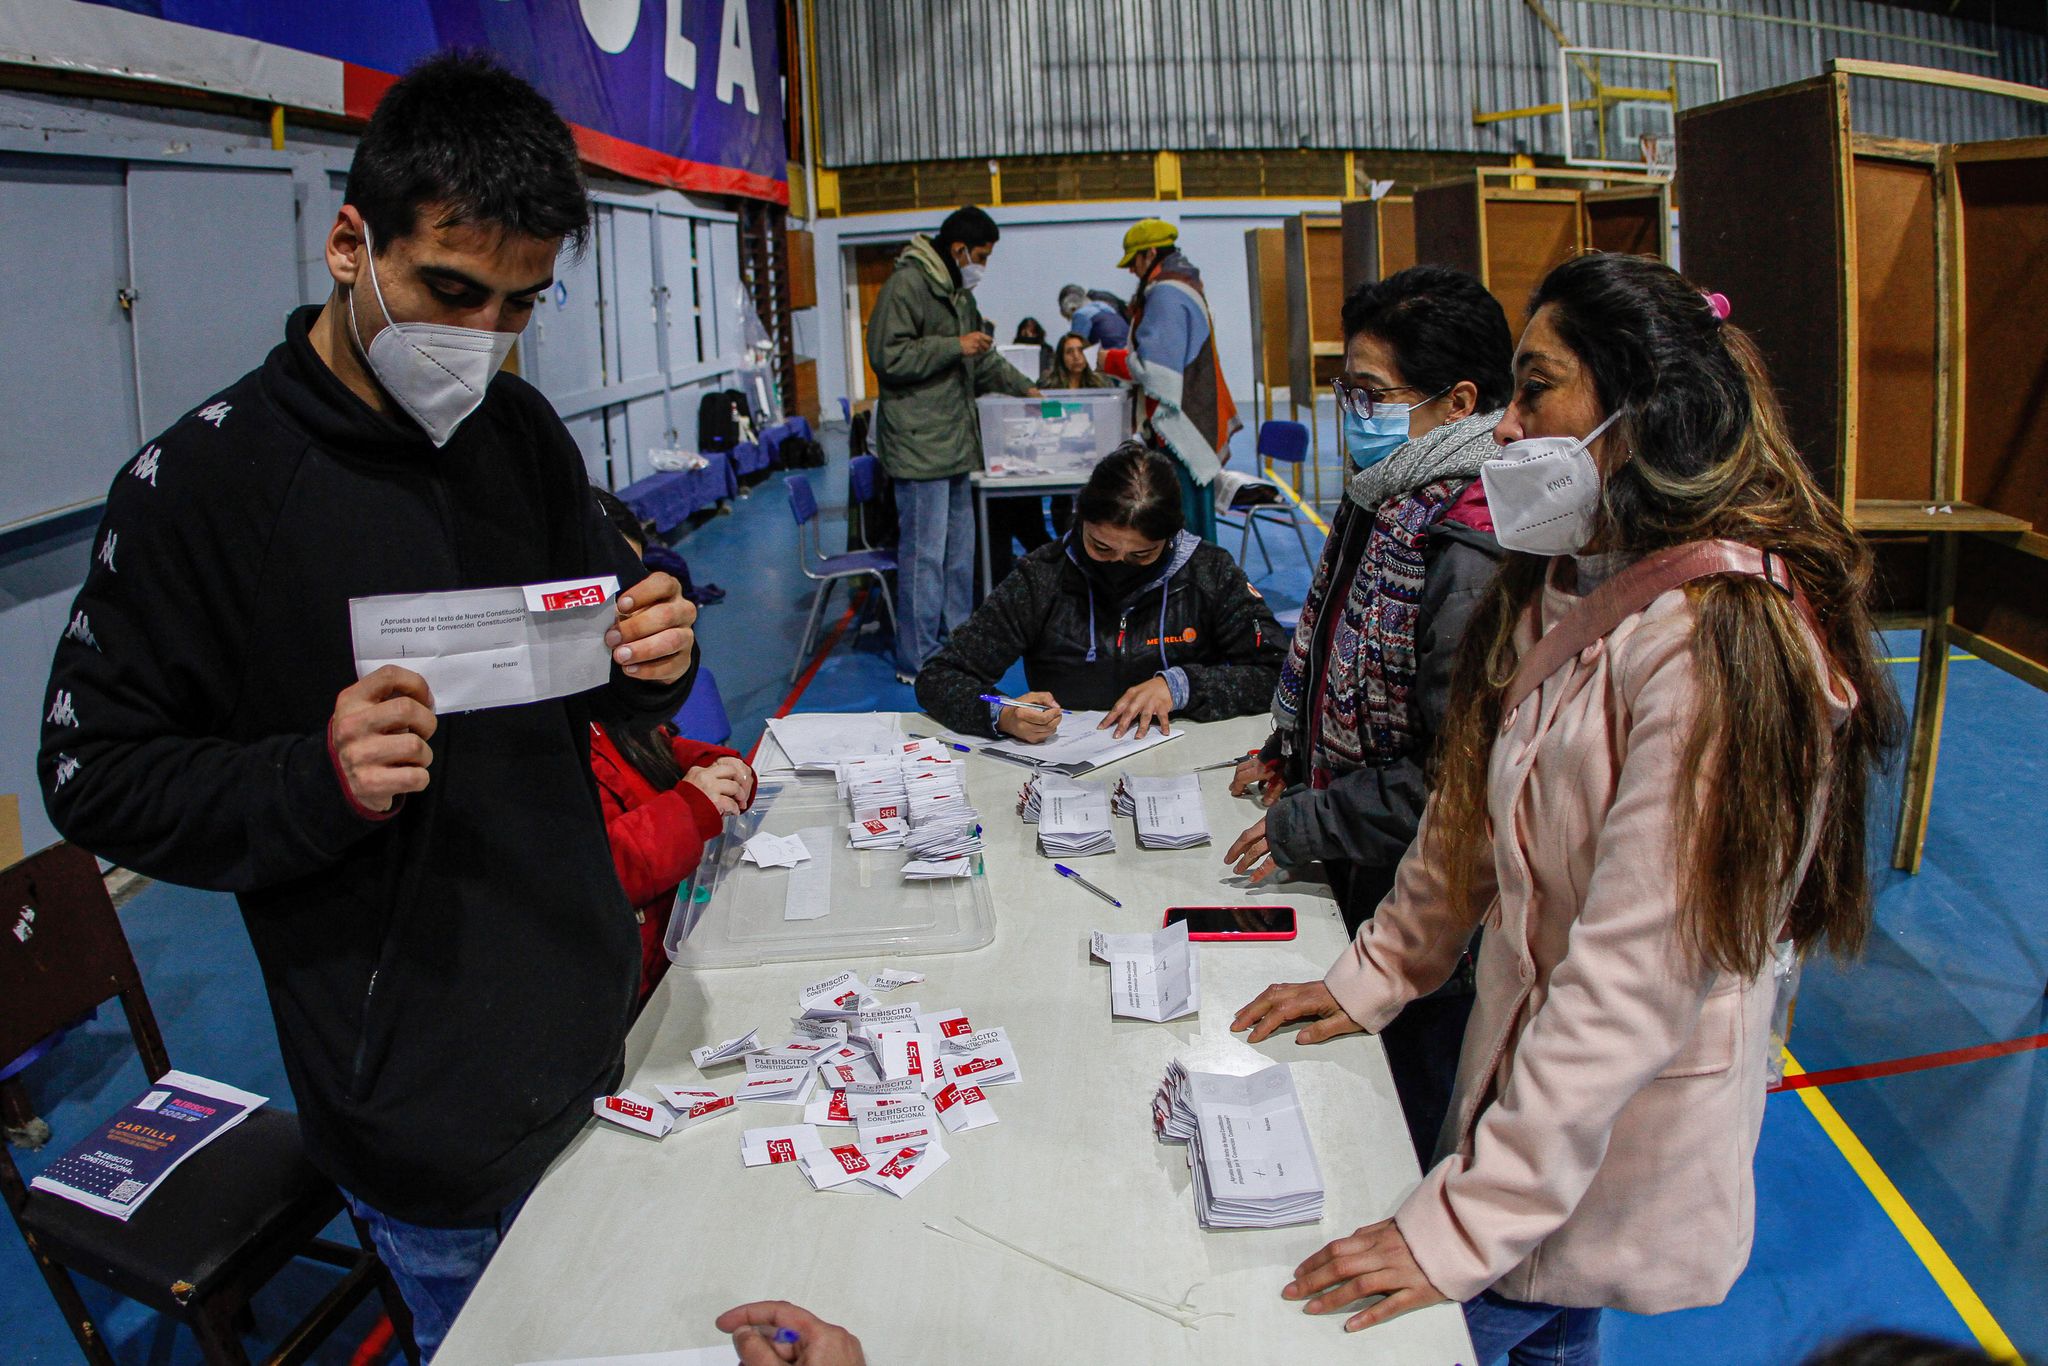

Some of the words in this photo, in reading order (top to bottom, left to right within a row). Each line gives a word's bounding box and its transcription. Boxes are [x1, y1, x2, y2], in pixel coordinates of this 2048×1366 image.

[1546, 475, 1573, 493] KN95
[412, 615, 430, 624] usted
[438, 614, 454, 622] texto
[455, 613, 463, 621] de
[465, 612, 485, 620] Nueva
[381, 626, 413, 635] propuesto
[415, 625, 426, 633] por
[437, 622, 475, 631] Convención
[1147, 635, 1185, 646] MERELL
[492, 661, 518, 669] Rechazo
[881, 808, 896, 818] SER
[806, 973, 849, 993] PLEBISCITO
[860, 1007, 912, 1018] PLEBISCITO
[860, 1014, 913, 1022] CONSTITUCIONAL
[754, 1058, 808, 1066] PLEBISCITO
[867, 1104, 925, 1117] PLEBISCITO
[867, 1112, 926, 1122] CONSTITUCIONAL
[115, 1121, 177, 1142] CARTILLA
[769, 1142, 792, 1154] SER
[94, 1150, 133, 1166] PLEBISCITO
[842, 1156, 867, 1170] SER
[79, 1154, 135, 1175] CONSTITUCIONAL
